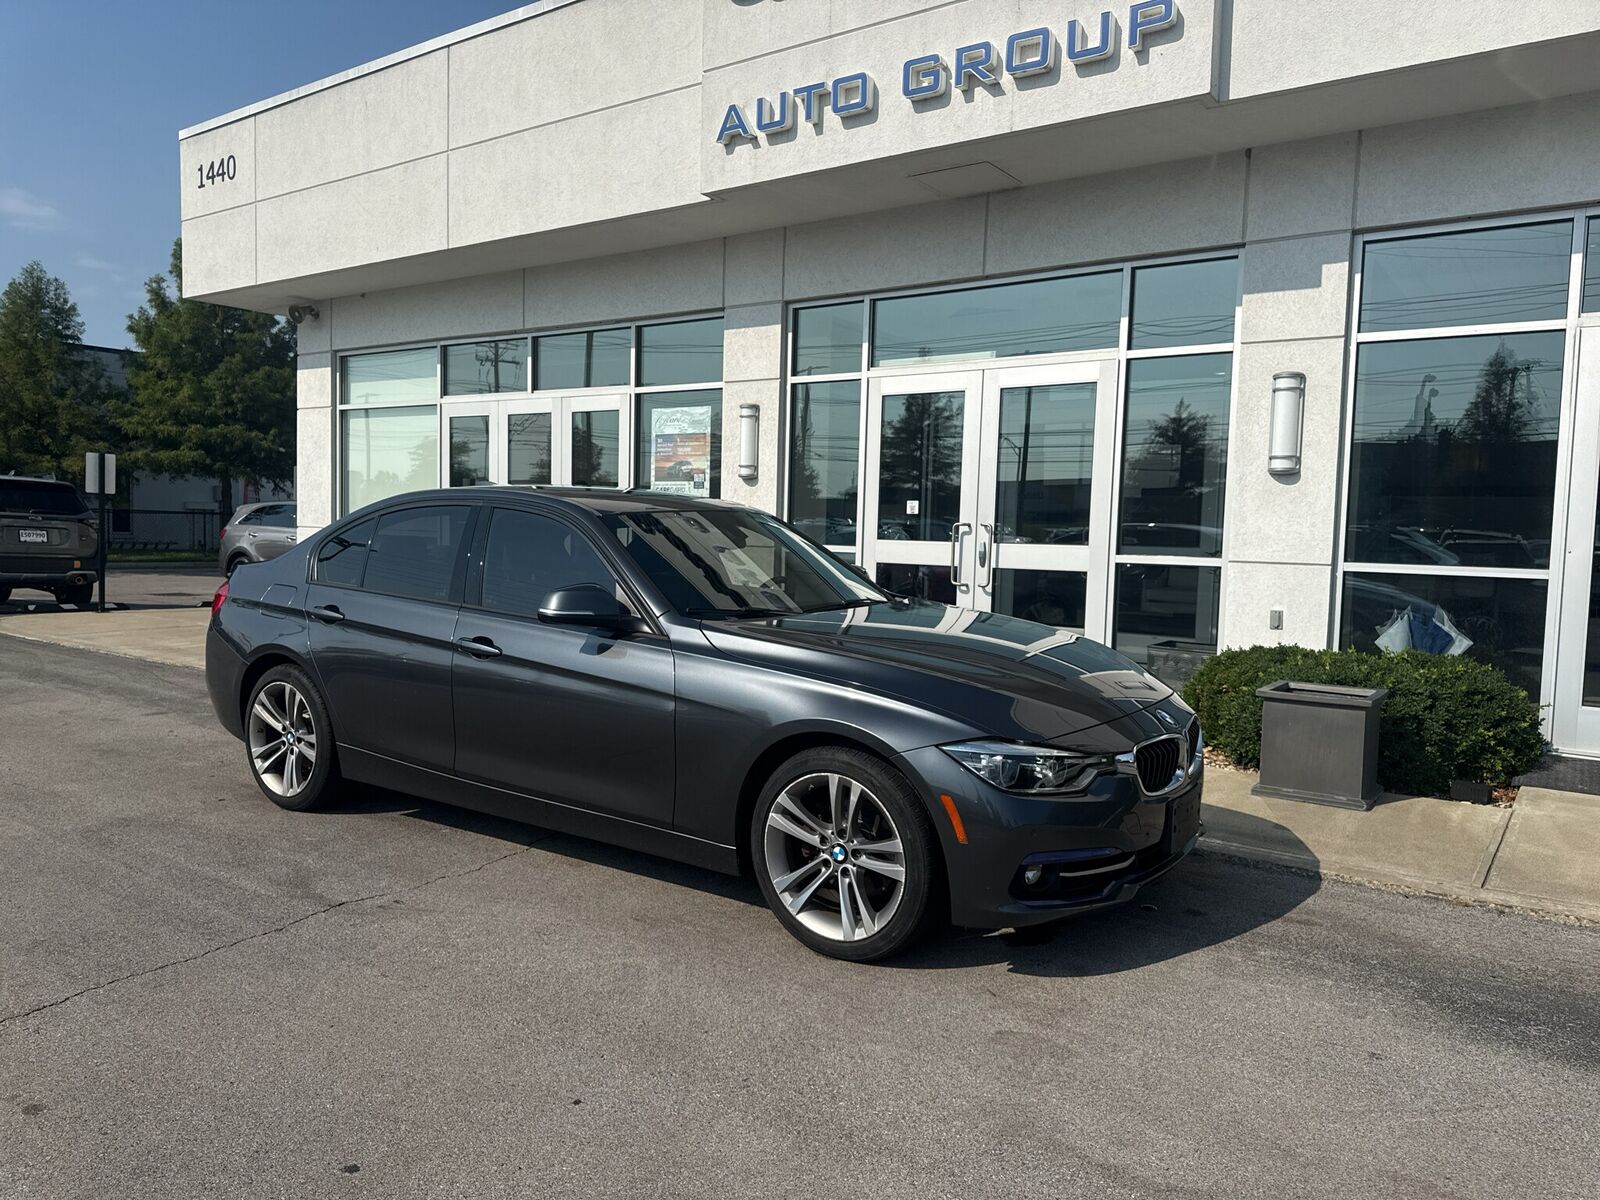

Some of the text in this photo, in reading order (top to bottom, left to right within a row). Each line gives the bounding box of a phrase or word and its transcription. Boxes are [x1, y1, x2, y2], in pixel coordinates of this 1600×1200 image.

[716, 0, 1178, 144] AUTO GROUP
[197, 154, 237, 189] 1440
